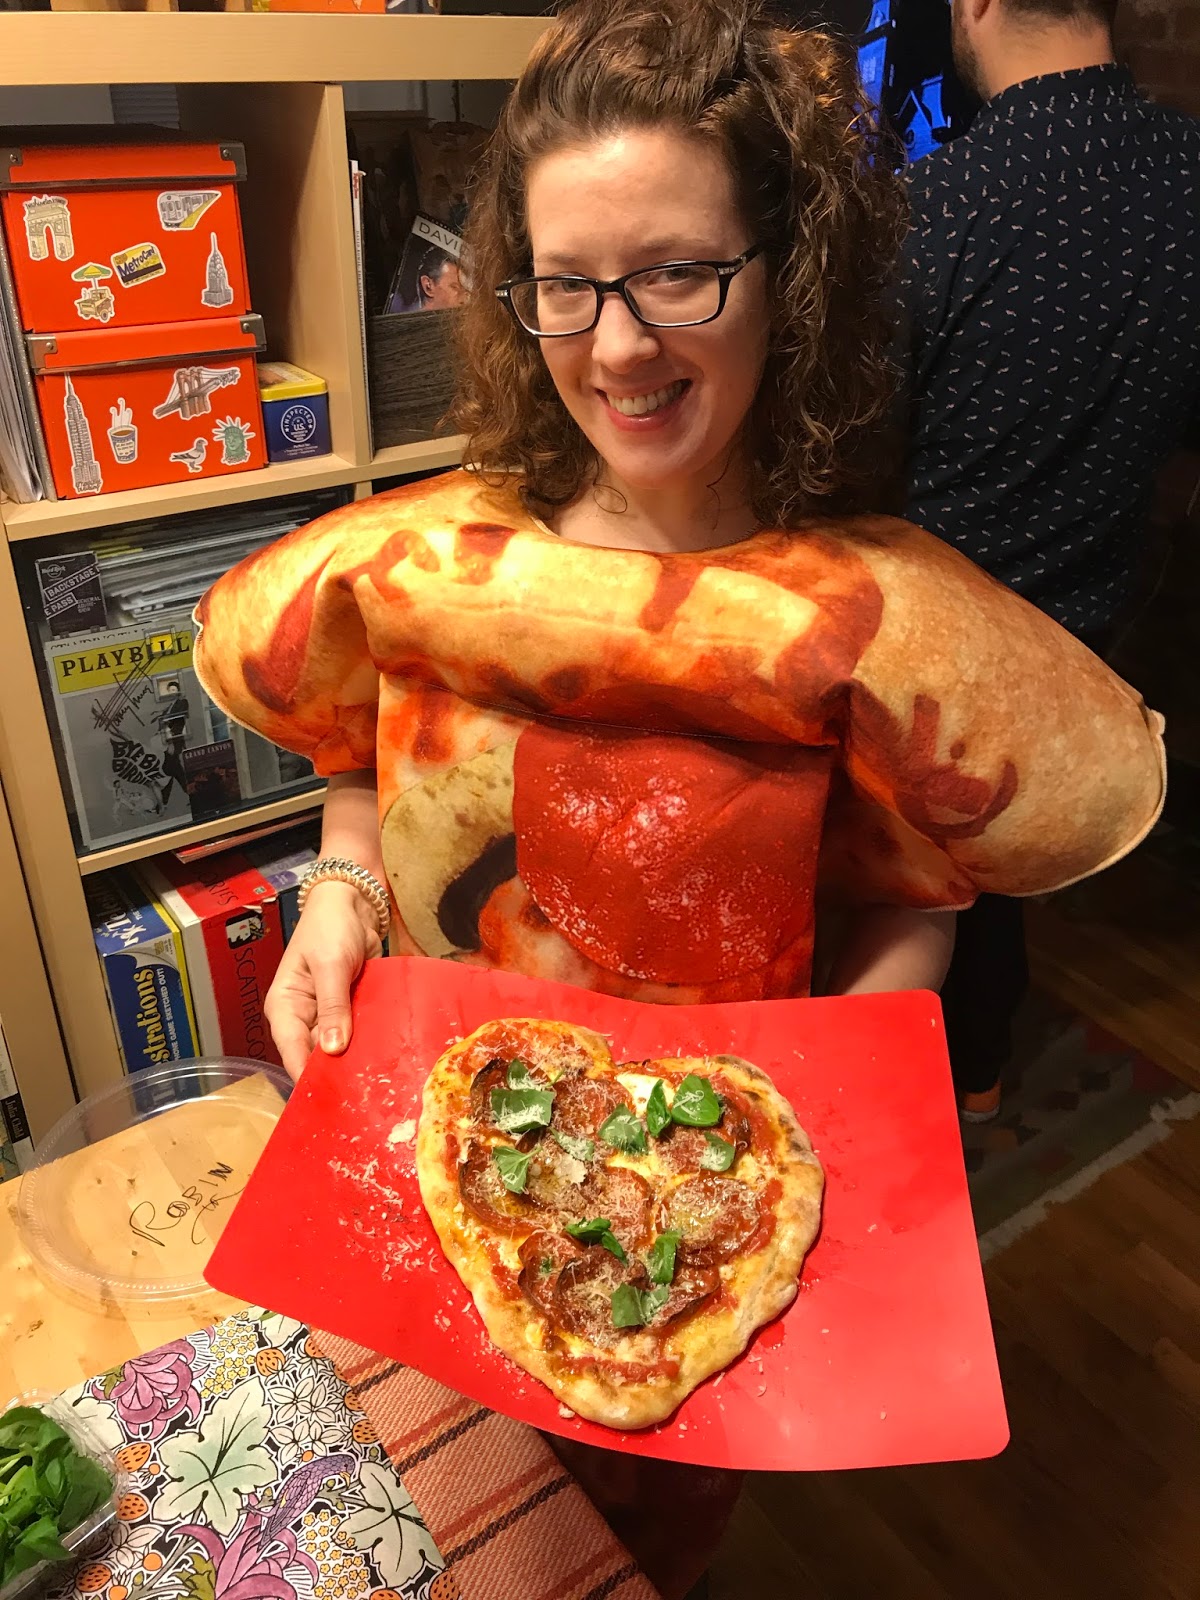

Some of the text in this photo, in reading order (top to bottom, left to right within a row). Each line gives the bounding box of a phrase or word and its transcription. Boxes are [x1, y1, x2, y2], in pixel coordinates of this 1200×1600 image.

[419, 222, 459, 250] DAVI
[117, 246, 155, 276] MetroCard
[284, 408, 313, 427] INSPECTED
[48, 568, 96, 597] BACKSTAGE
[51, 596, 73, 612] PASS
[60, 636, 190, 677] PLAYBILL
[110, 738, 166, 781] BYE BYE
[185, 742, 232, 759] GRAND CANYON
[156, 967, 166, 985] OUT!
[133, 968, 171, 1064] strations
[160, 985, 173, 1021] SKETCHED
[167, 1021, 177, 1041] GAME
